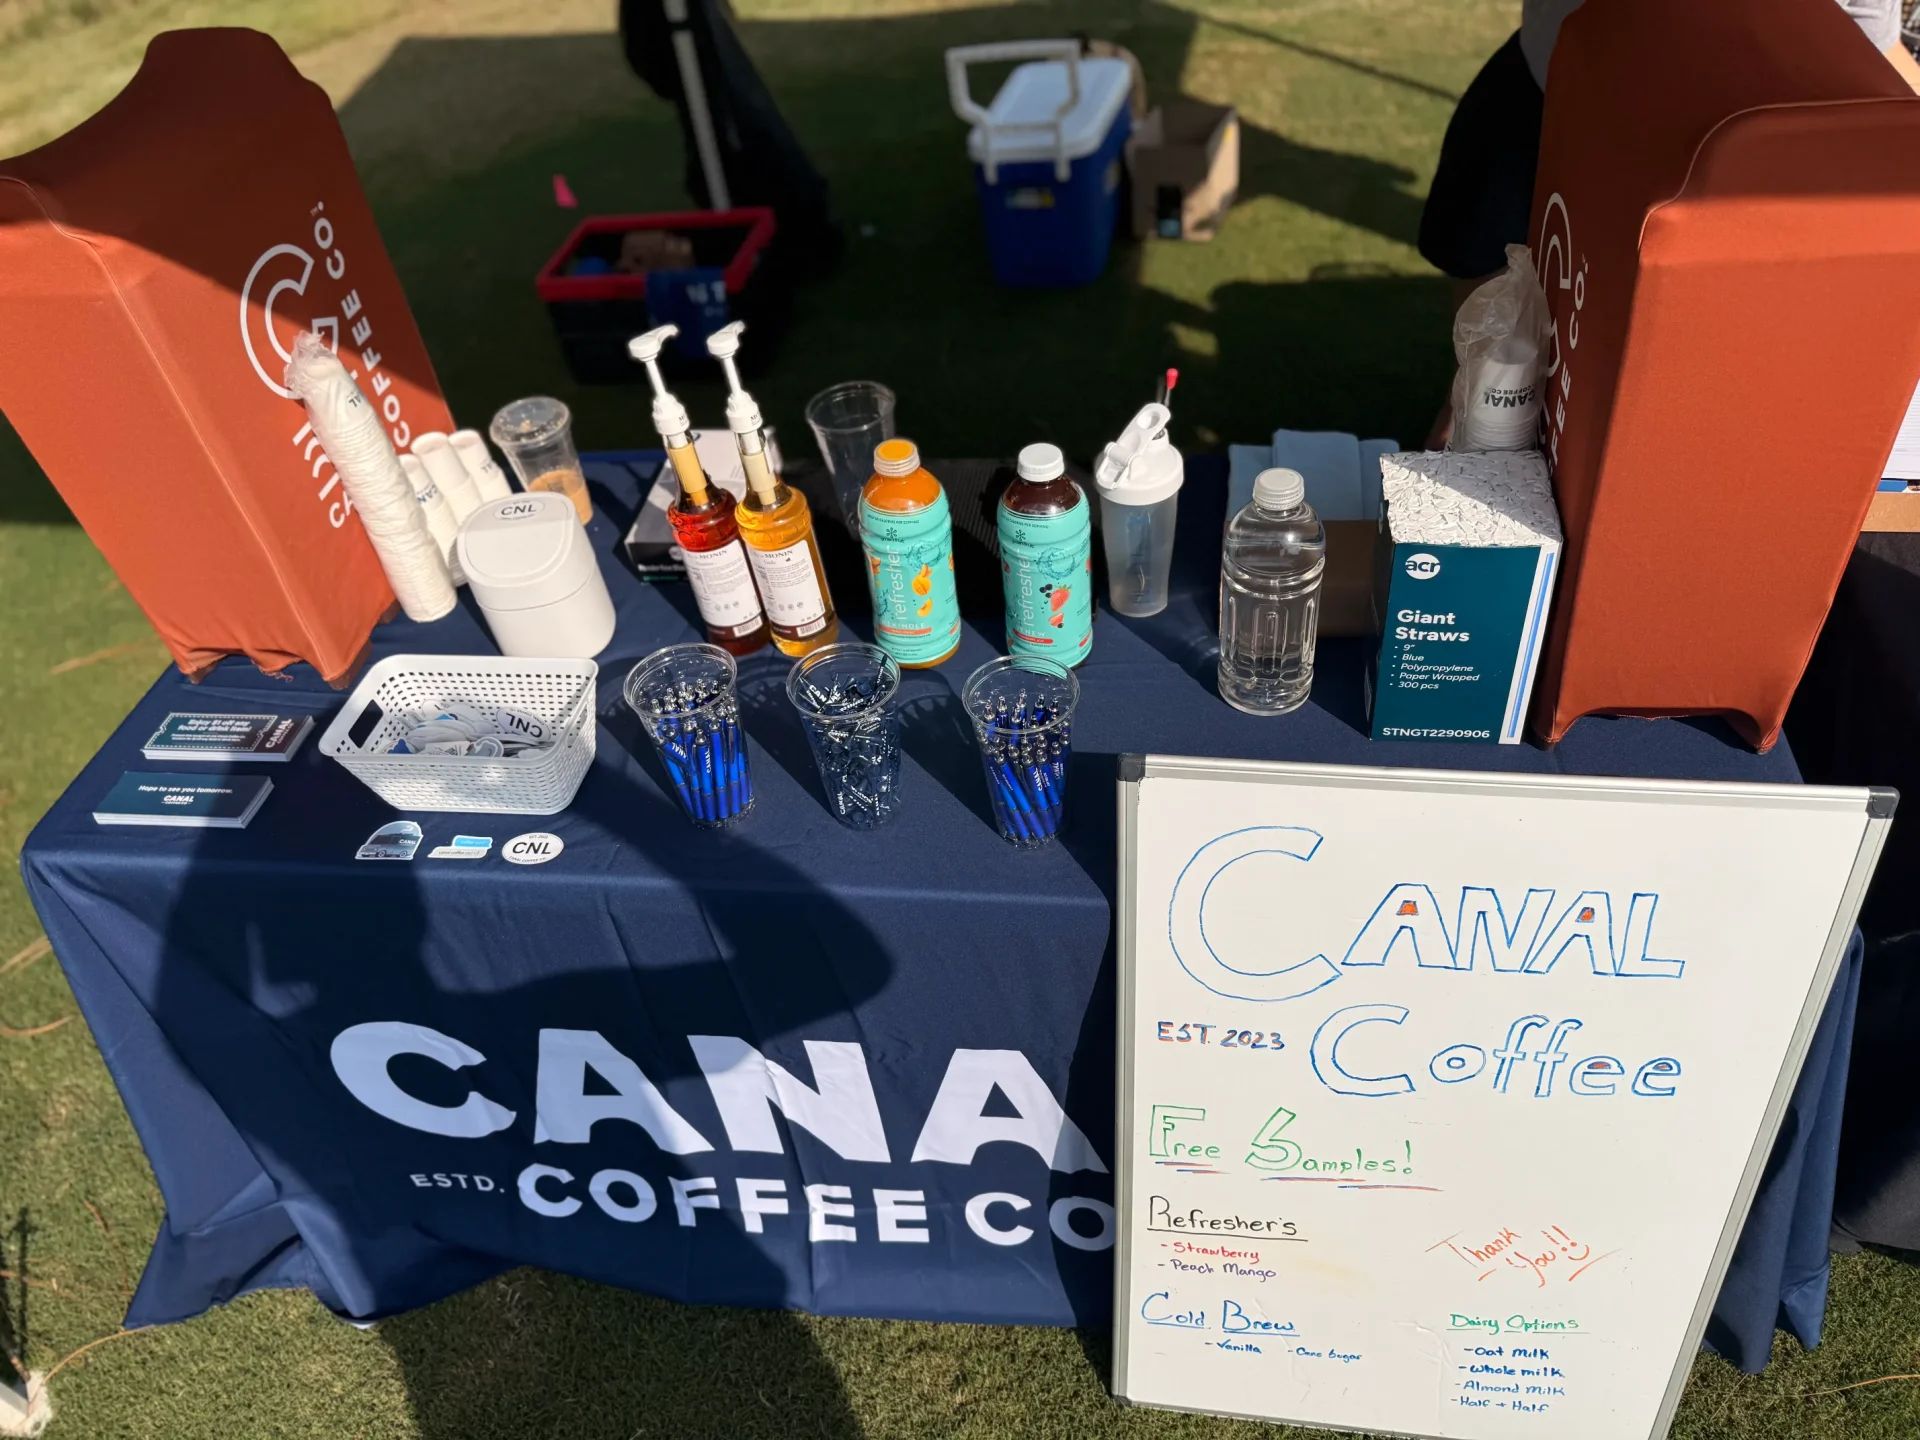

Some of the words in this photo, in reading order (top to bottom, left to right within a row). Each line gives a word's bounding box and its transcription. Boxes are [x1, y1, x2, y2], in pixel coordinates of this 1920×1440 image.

[341, 289, 411, 449] COFFEE
[501, 504, 537, 516] CNL
[764, 550, 793, 559] MONIN
[886, 545, 907, 619] refresher
[1016, 549, 1034, 628] refresher
[1397, 609, 1456, 625] Giant
[1395, 627, 1470, 642] Straws
[1400, 663, 1474, 672] Polypropylene
[1402, 653, 1425, 661] Blue
[1398, 681, 1419, 689] 300
[1399, 672, 1430, 680] Paper
[1432, 673, 1480, 682] Wrapped
[266, 718, 293, 748] CANAL
[506, 713, 543, 738] CNL
[1382, 727, 1490, 738] STNGT2290906
[512, 842, 551, 854] CNL
[1169, 826, 1686, 1002] CANAL
[1220, 1029, 1285, 1050] 2023
[1310, 1004, 1682, 1098] Coffee
[329, 1021, 1109, 1175] CANA
[1149, 1104, 1221, 1160] Free
[1244, 1107, 1414, 1175] Samples!
[409, 1172, 506, 1194] ESTD.
[516, 1162, 930, 1244] COFFEE
[1149, 1195, 1298, 1236] Refresher's
[1173, 1241, 1260, 1264] Strawberry
[1424, 1227, 1522, 1268] Thank
[1170, 1258, 1214, 1273] Peach
[1223, 1262, 1277, 1282] Mango
[1141, 1292, 1206, 1326] Cold
[1222, 1299, 1295, 1332] Brew
[1450, 1313, 1500, 1336] Dairy
[1506, 1315, 1580, 1331] Options
[1216, 1339, 1263, 1354] Vanilla
[1512, 1401, 1550, 1412] Half
